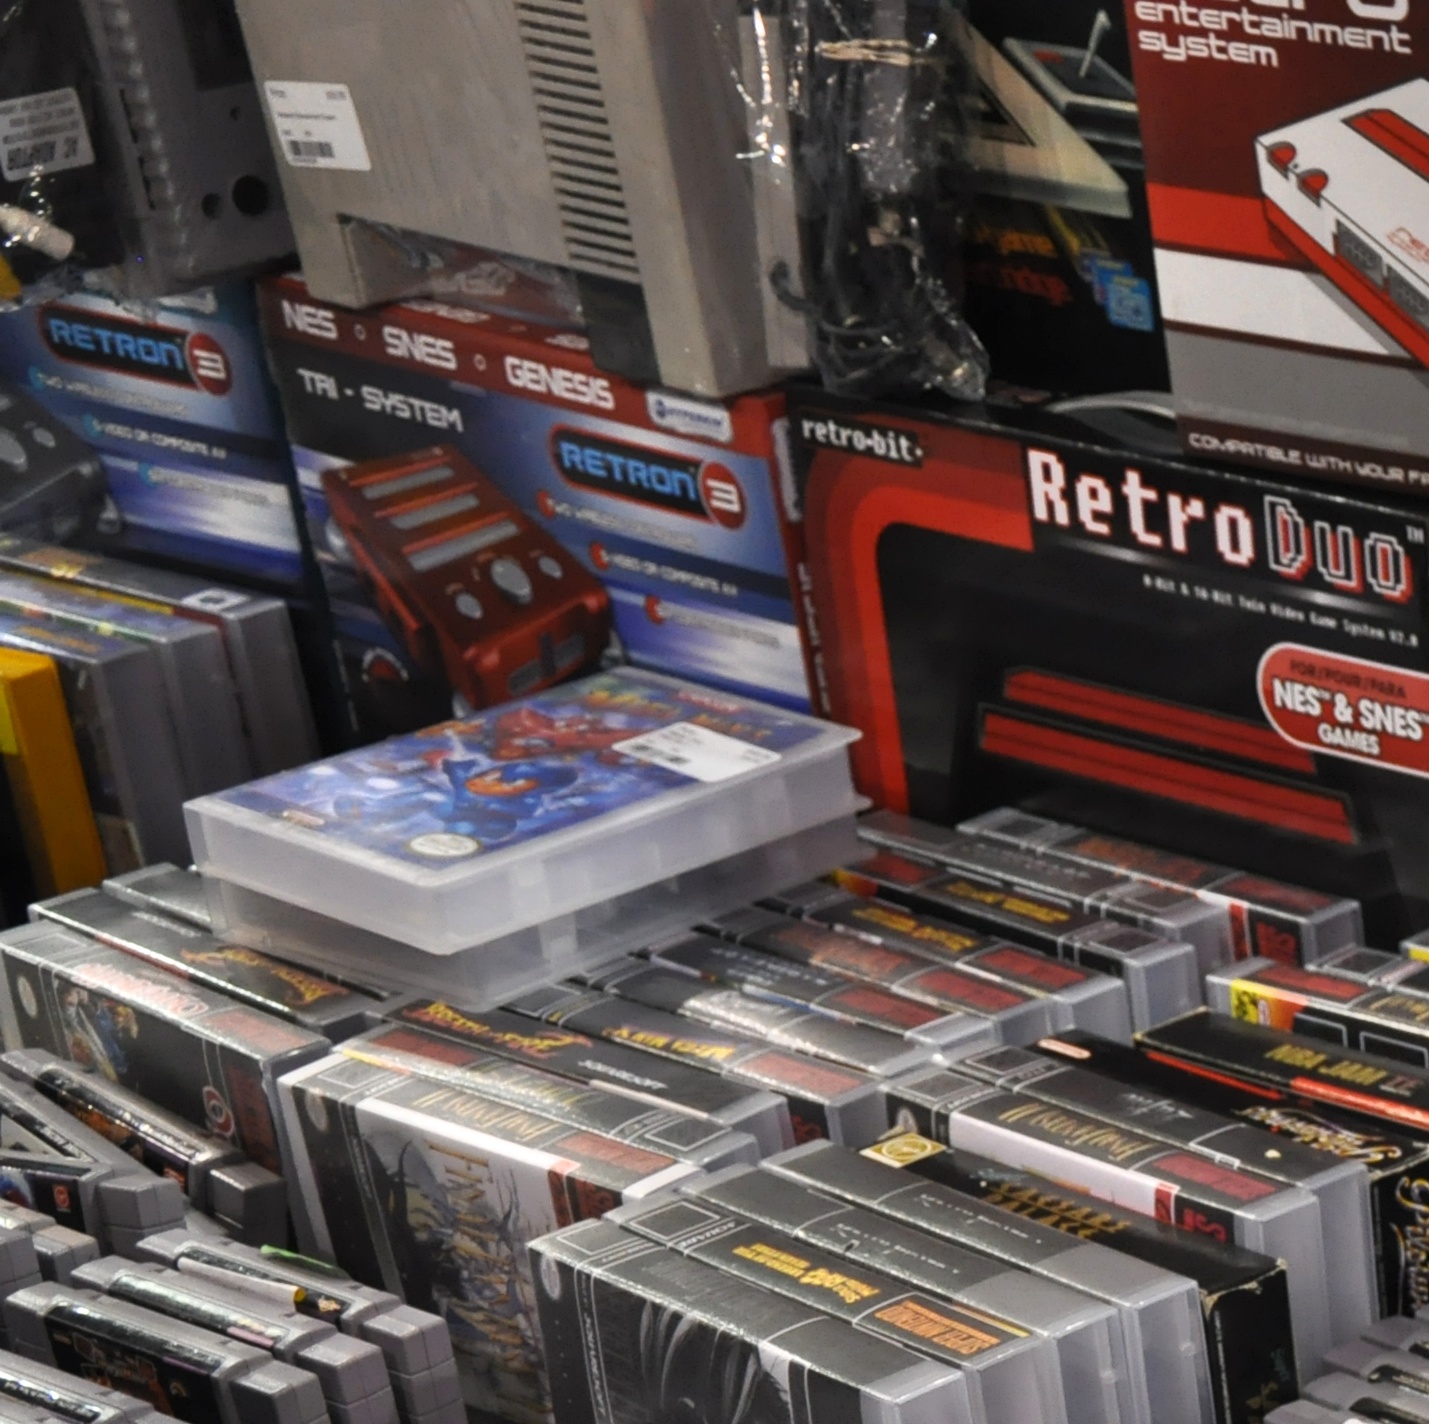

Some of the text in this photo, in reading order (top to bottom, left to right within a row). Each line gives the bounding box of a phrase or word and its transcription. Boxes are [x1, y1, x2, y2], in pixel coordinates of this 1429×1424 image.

[1134, 2, 1412, 55] entertainment
[1138, 27, 1279, 67] system
[48, 317, 185, 370] RETRON
[281, 299, 615, 411] NES SNES GENESIS
[298, 367, 465, 434] TRI SYSTEM
[557, 439, 698, 501] RETRON
[1188, 431, 1303, 466] COMPATIBLE
[1307, 452, 1352, 475] WITH
[1027, 447, 1255, 569] Retro
[1318, 723, 1380, 757] GAMES
[1264, 1042, 1387, 1089] NBA JAM
